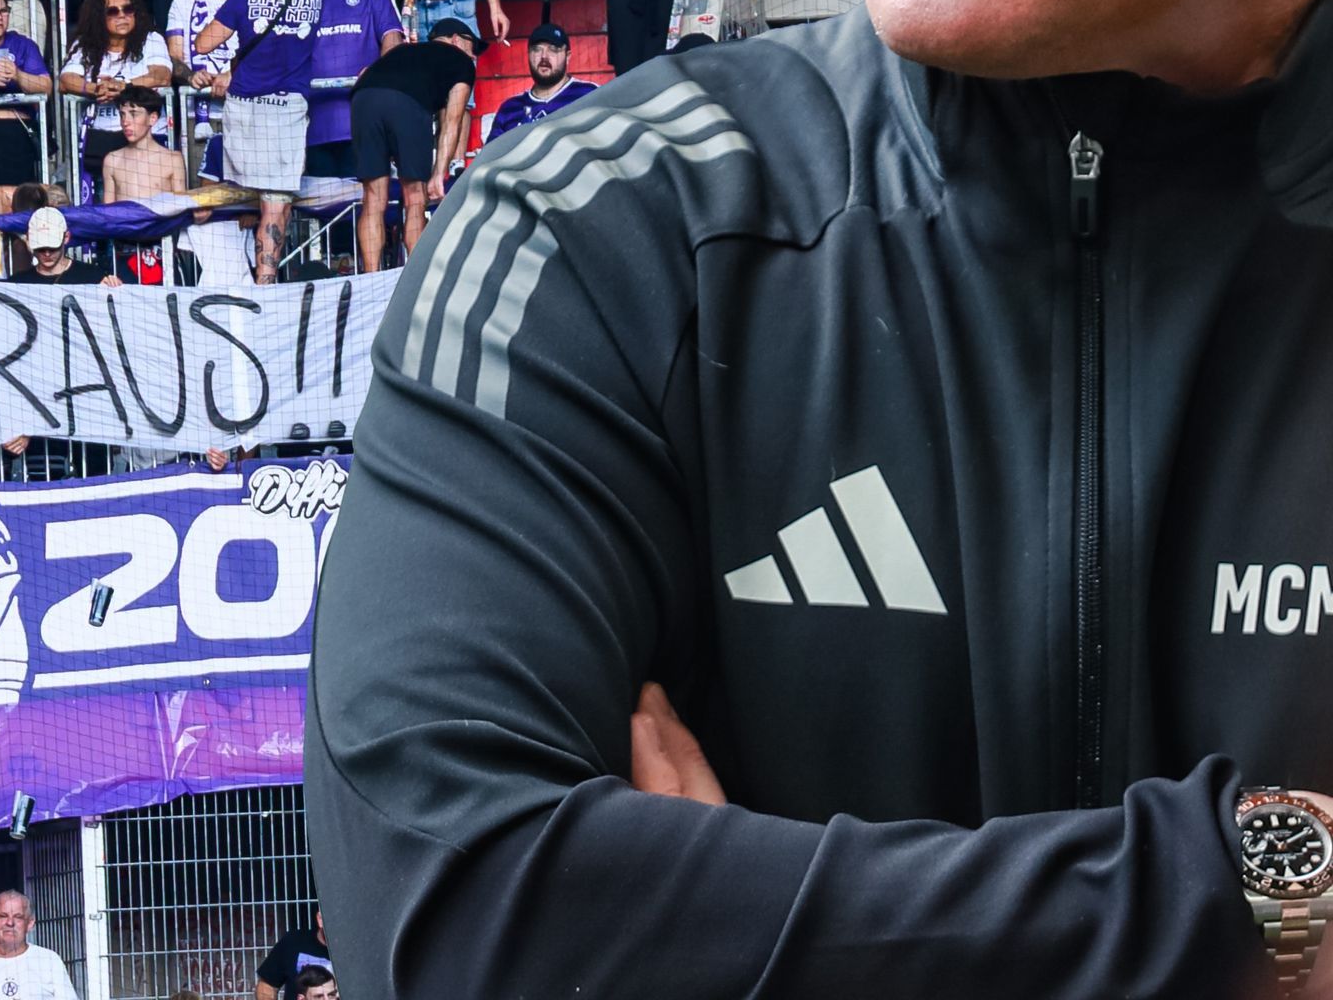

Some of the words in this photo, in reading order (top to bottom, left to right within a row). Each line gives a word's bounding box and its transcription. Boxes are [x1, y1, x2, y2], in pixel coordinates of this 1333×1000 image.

[317, 24, 363, 37] NKSTAHL
[99, 106, 117, 117] EEL
[249, 460, 349, 520] Diffi
[40, 503, 337, 653] 20
